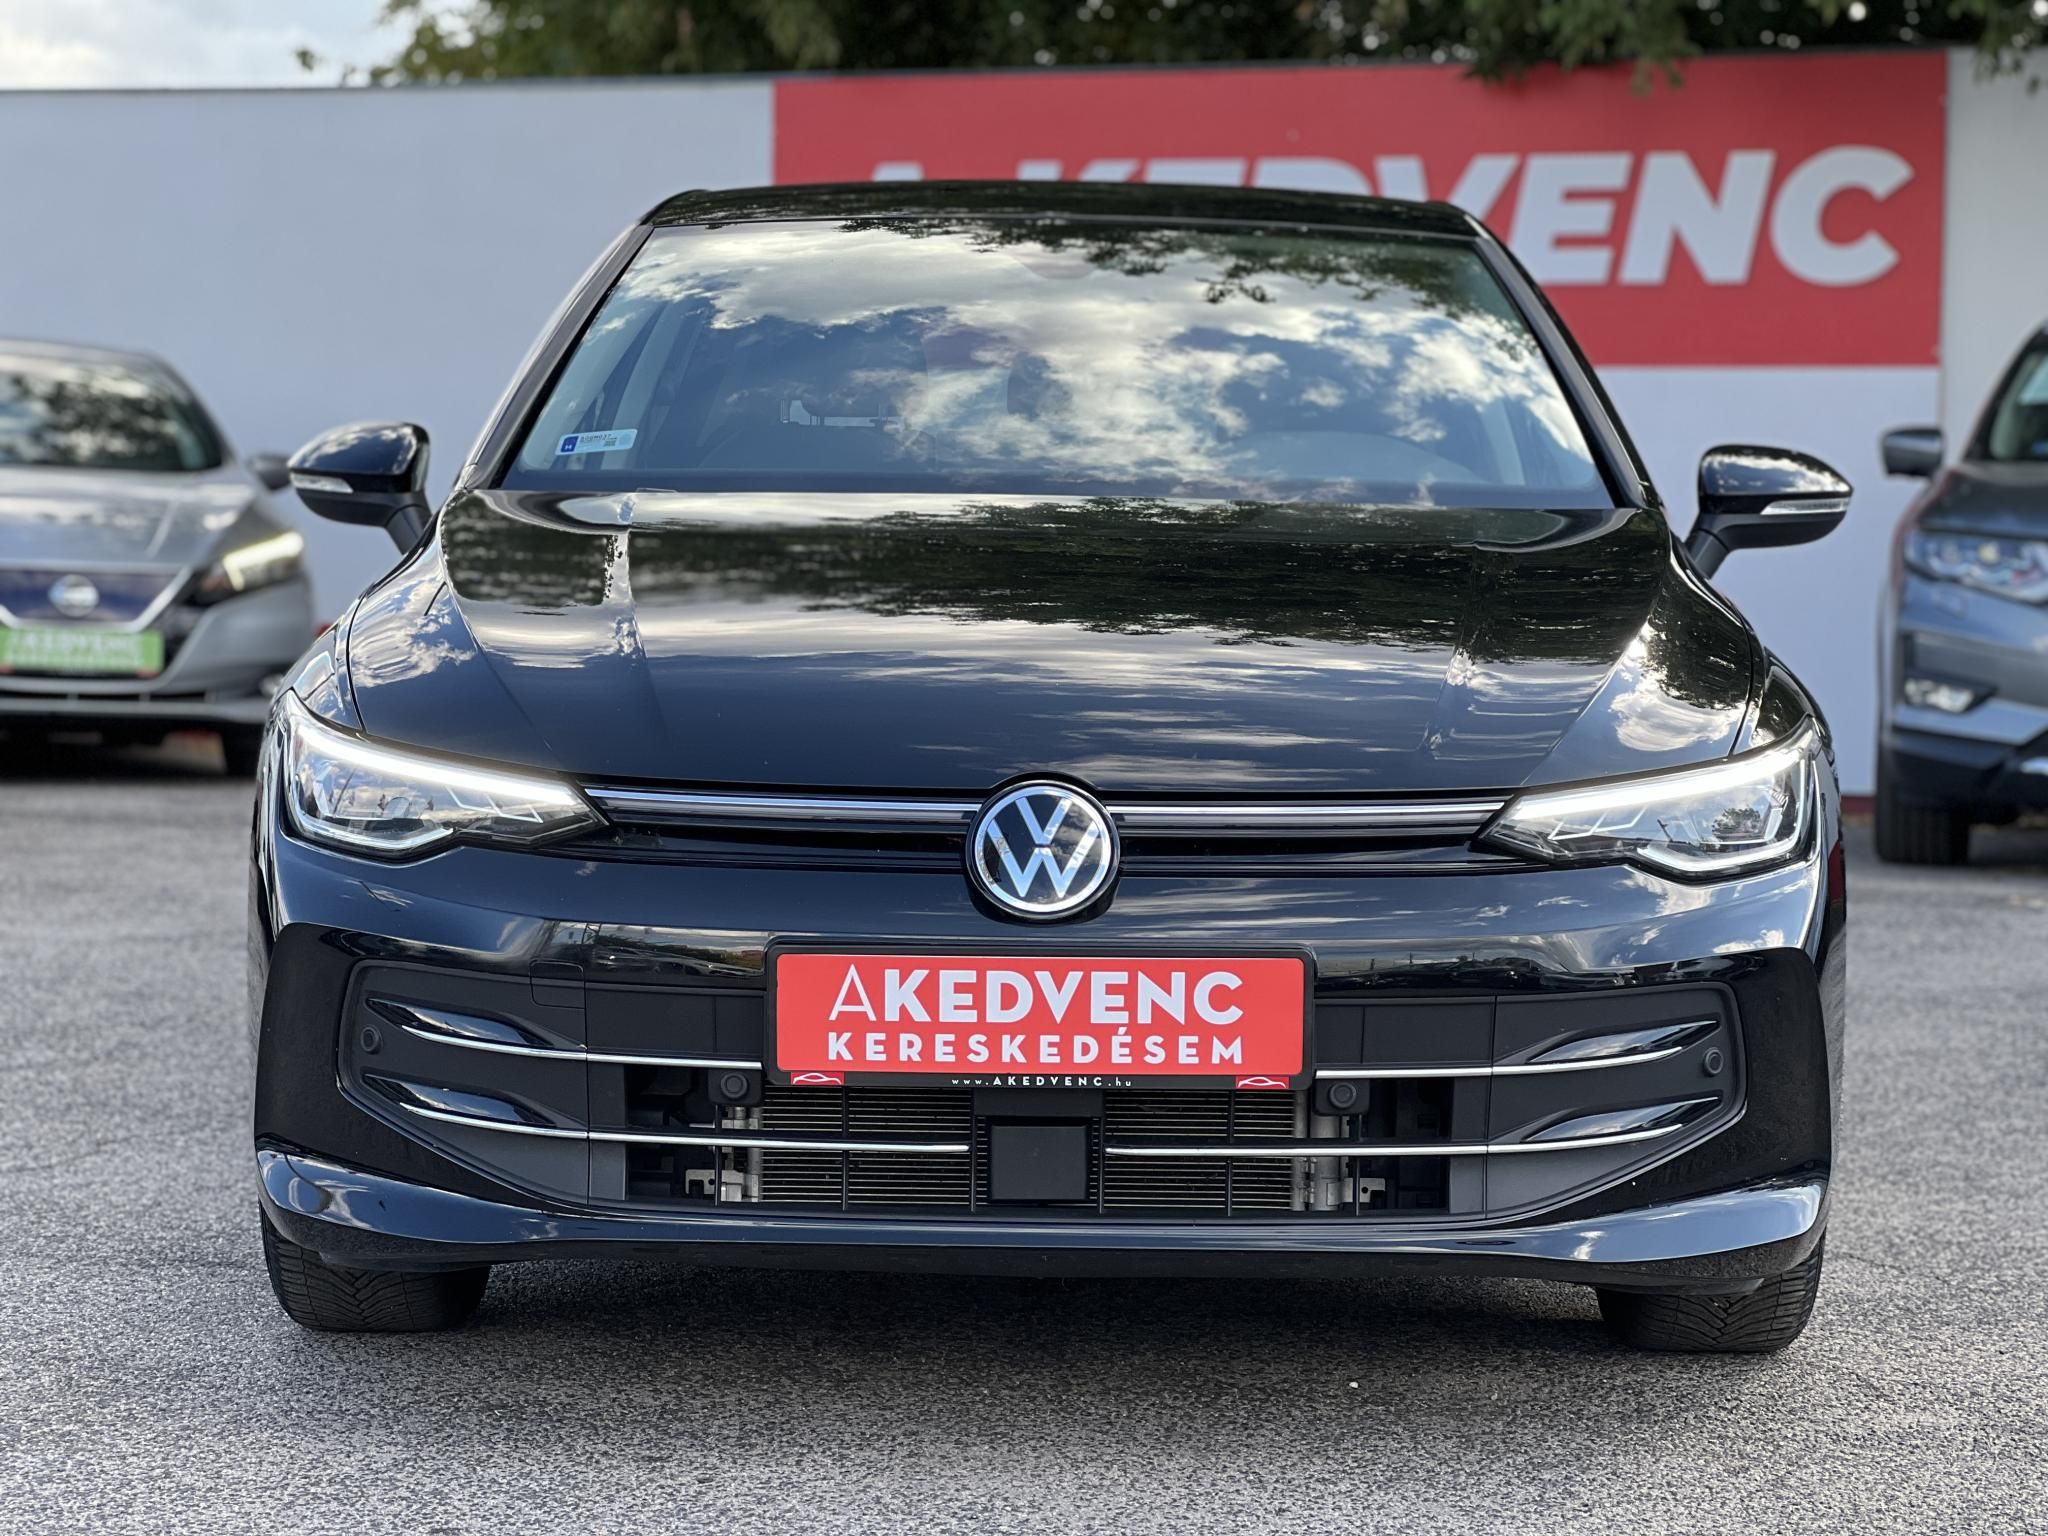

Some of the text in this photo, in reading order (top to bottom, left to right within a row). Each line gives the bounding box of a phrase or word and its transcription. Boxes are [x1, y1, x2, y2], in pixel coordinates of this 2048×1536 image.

[986, 796, 1100, 899] VW
[828, 1027, 1243, 1065] KERESKEDÉSEM
[951, 1076, 1132, 1087] www.AKEDVENC.hu
